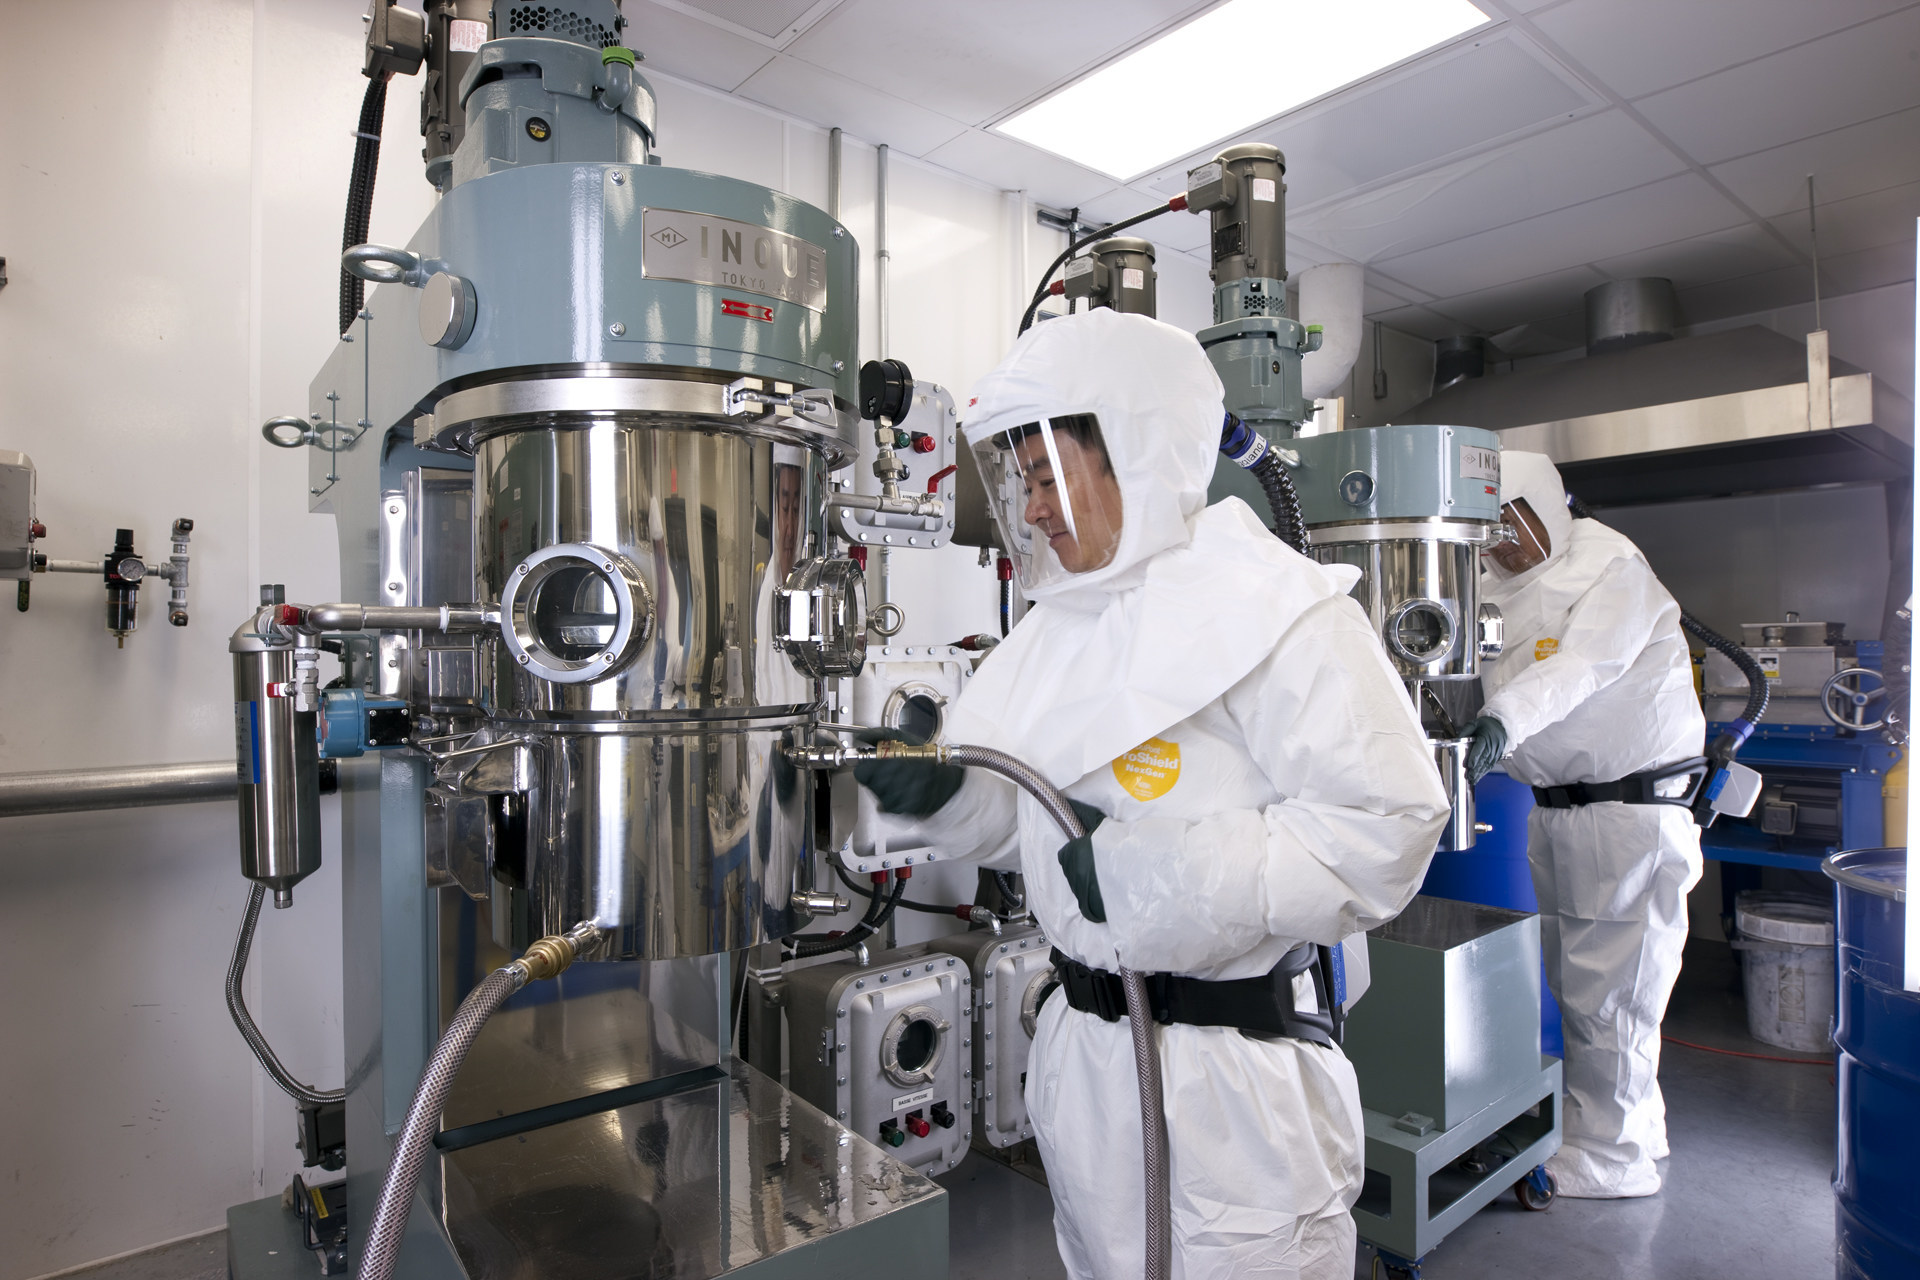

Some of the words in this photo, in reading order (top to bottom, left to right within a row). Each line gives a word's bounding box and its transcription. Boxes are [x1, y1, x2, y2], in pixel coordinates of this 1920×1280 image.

[661, 232, 677, 243] MI
[700, 225, 820, 289] INOUE
[721, 271, 766, 290] TOKYO
[1122, 751, 1178, 770] roShield
[1125, 763, 1165, 779] NexGen
